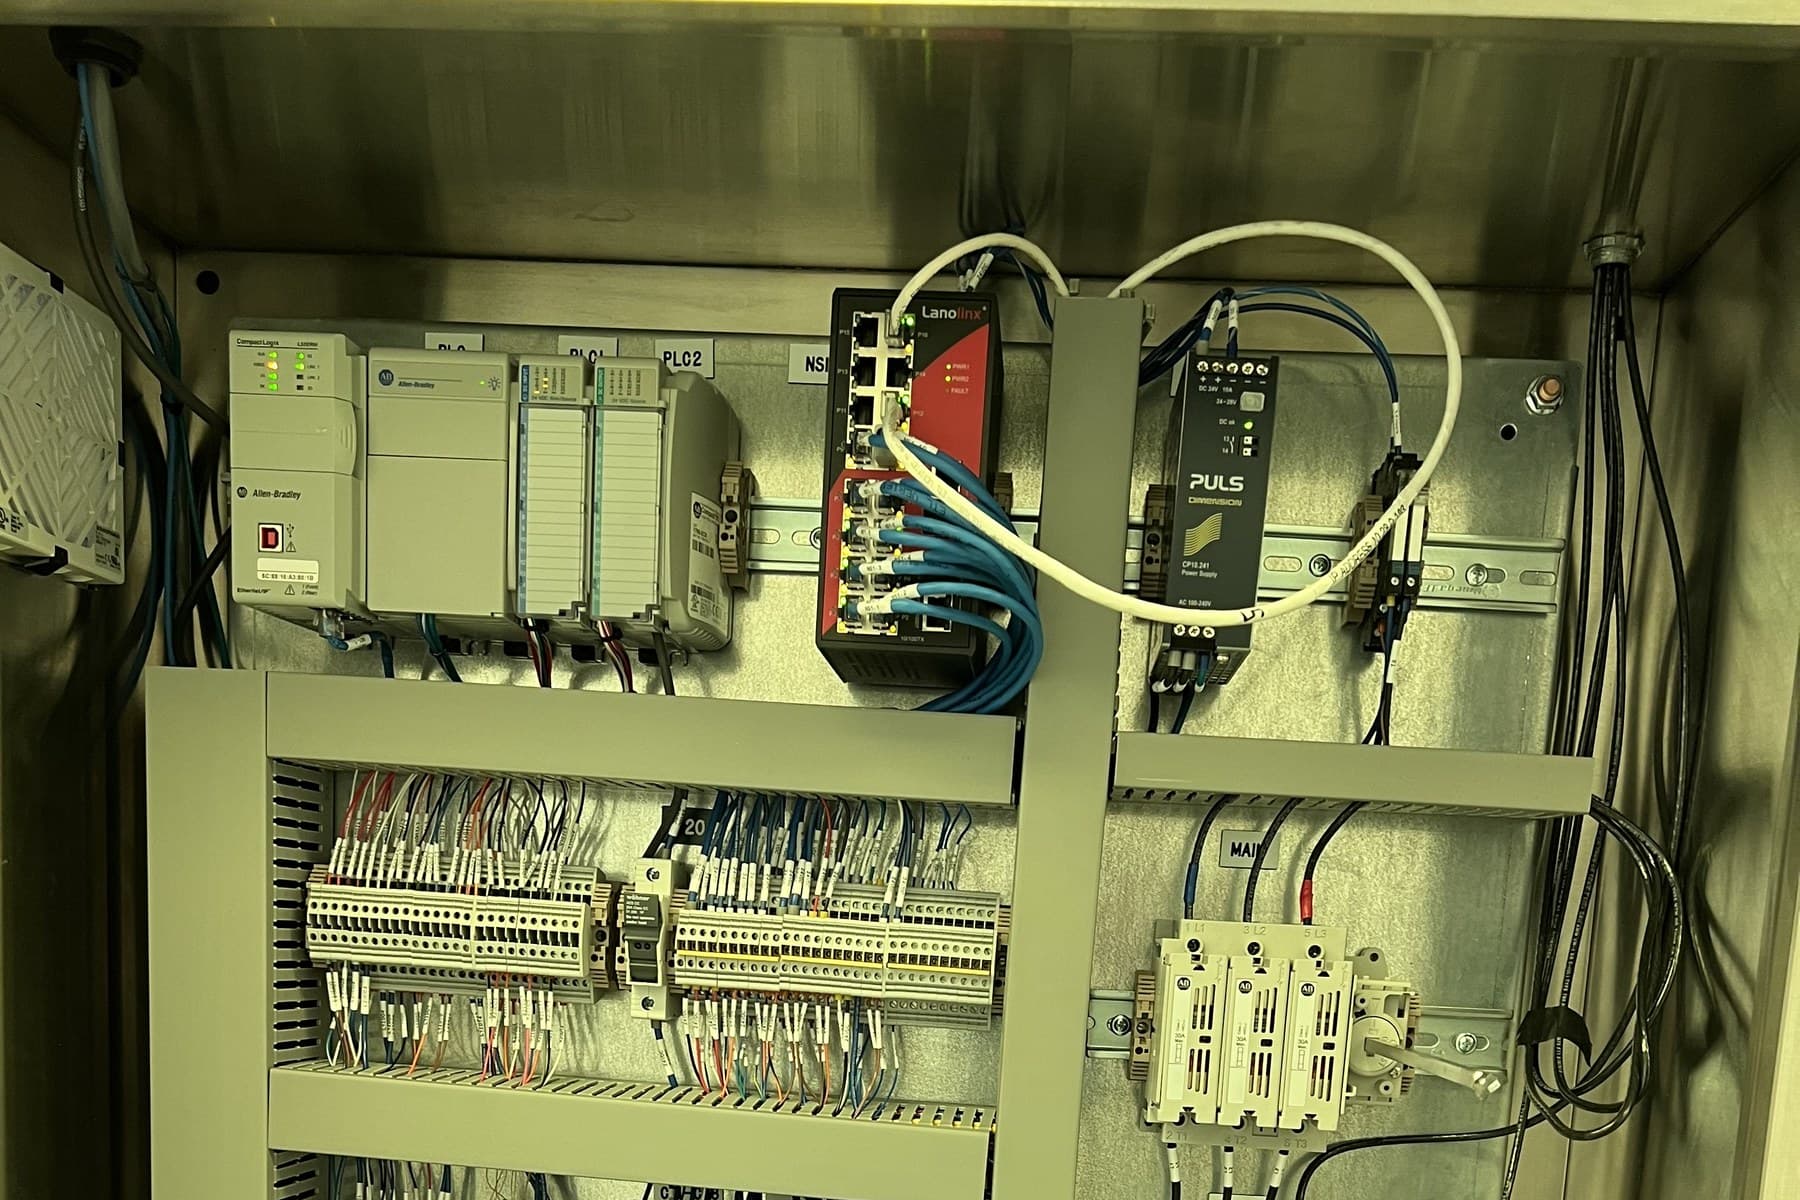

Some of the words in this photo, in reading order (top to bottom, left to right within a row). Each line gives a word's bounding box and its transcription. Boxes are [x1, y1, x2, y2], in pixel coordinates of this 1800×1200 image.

[663, 350, 702, 367] PLC2
[1189, 473, 1244, 492] PULS
[252, 488, 301, 501] Allen-Bradley
[1181, 569, 1199, 577] Power
[1199, 570, 1218, 579] Supply
[684, 818, 706, 836] 20
[1253, 926, 1266, 936] L2
[1304, 929, 1311, 938] 5
[1314, 929, 1327, 938] L3
[1234, 1136, 1247, 1145] T2
[1295, 1140, 1308, 1149] T3
